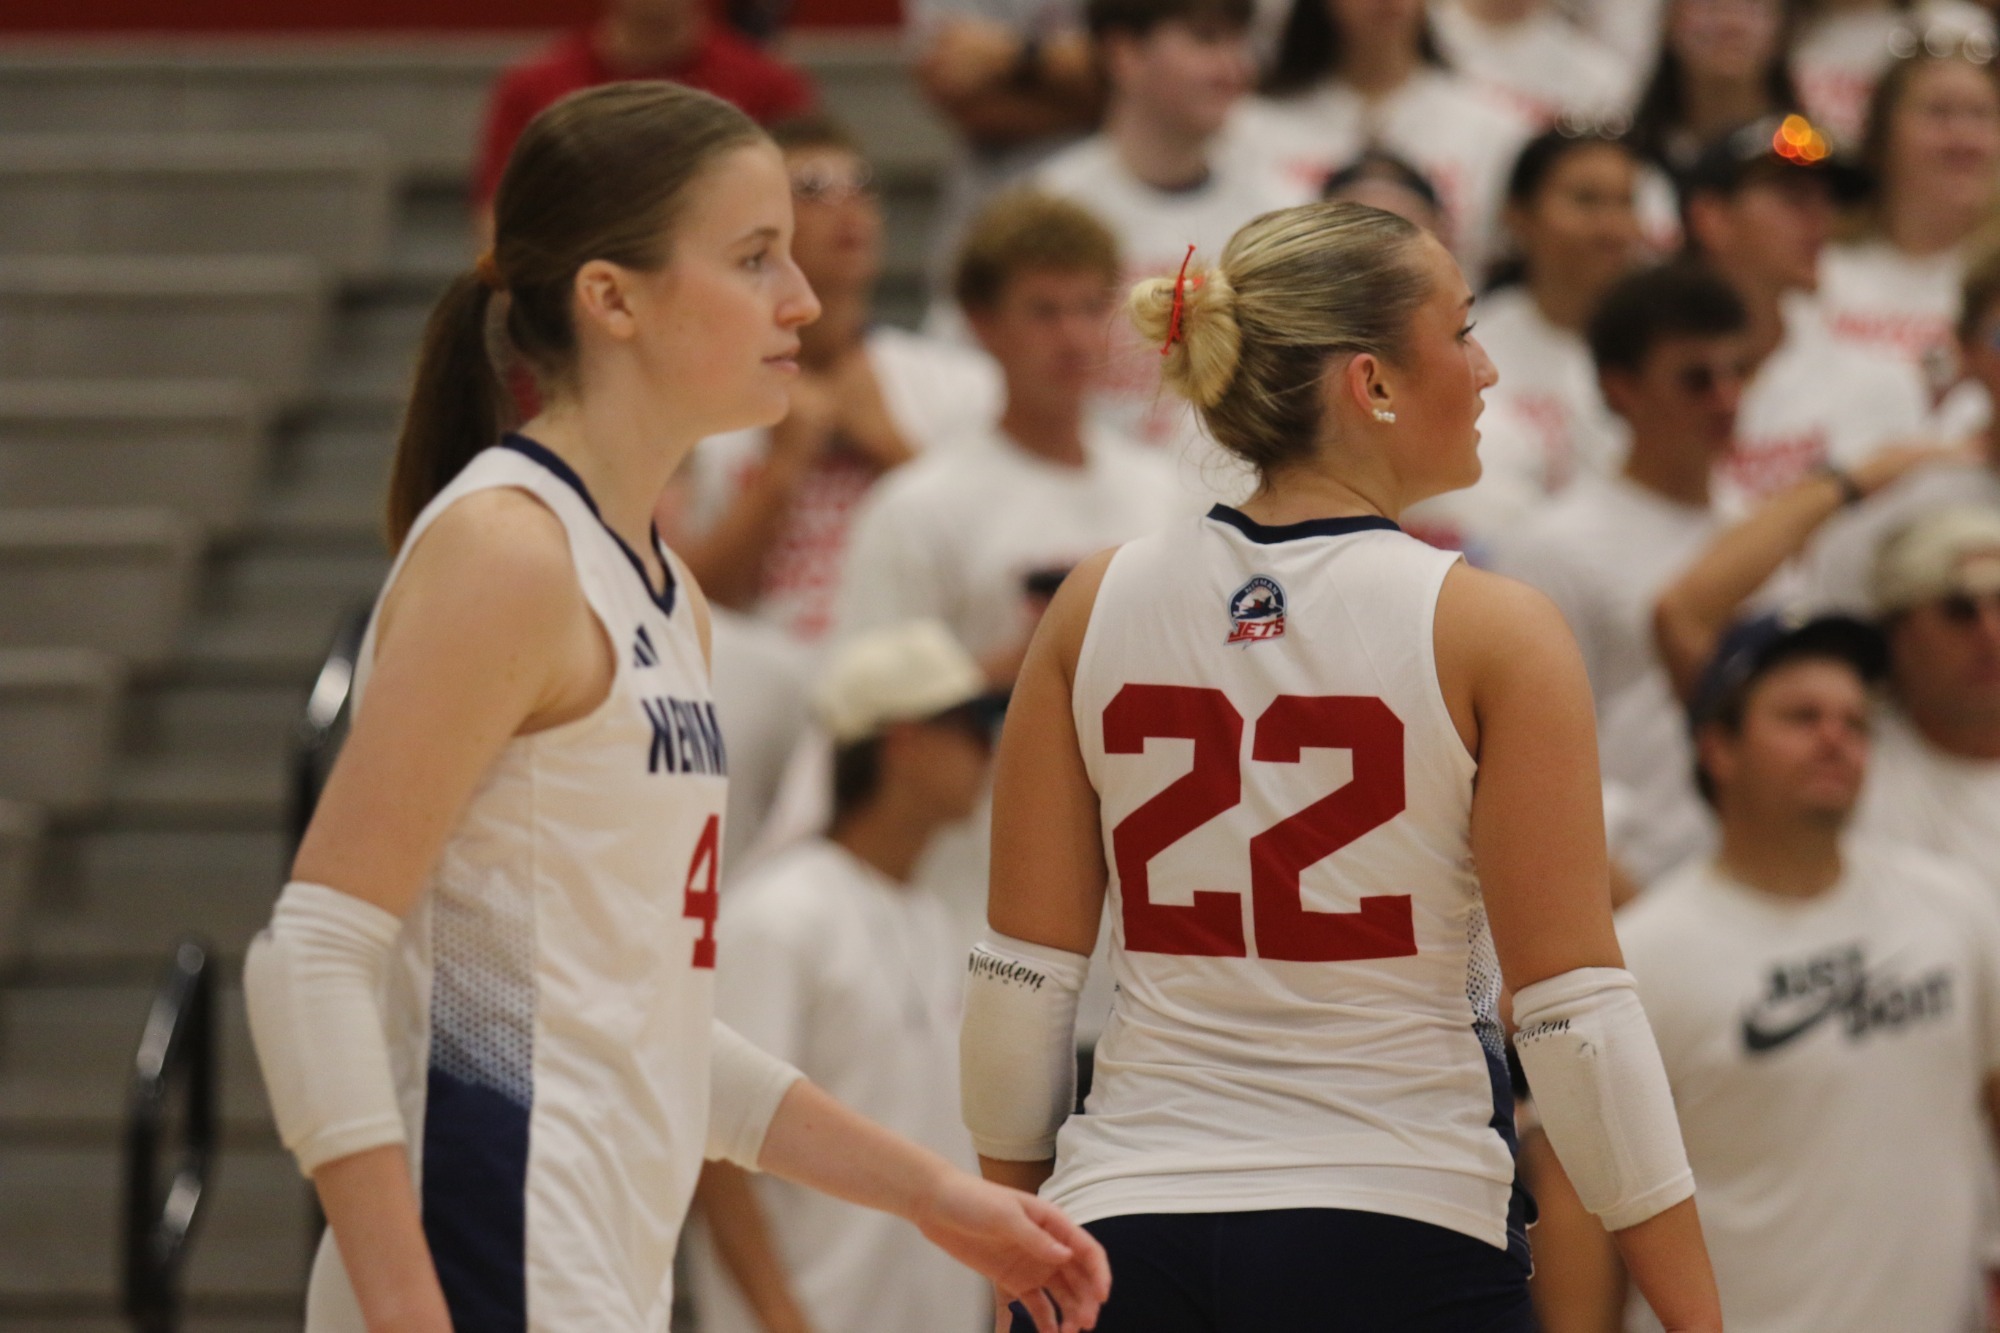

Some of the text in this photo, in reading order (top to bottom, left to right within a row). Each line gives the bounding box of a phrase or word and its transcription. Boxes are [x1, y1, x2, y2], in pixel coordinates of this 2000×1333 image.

[1227, 616, 1285, 643] JETS
[682, 813, 720, 969] 4
[1102, 683, 1418, 962] 22
